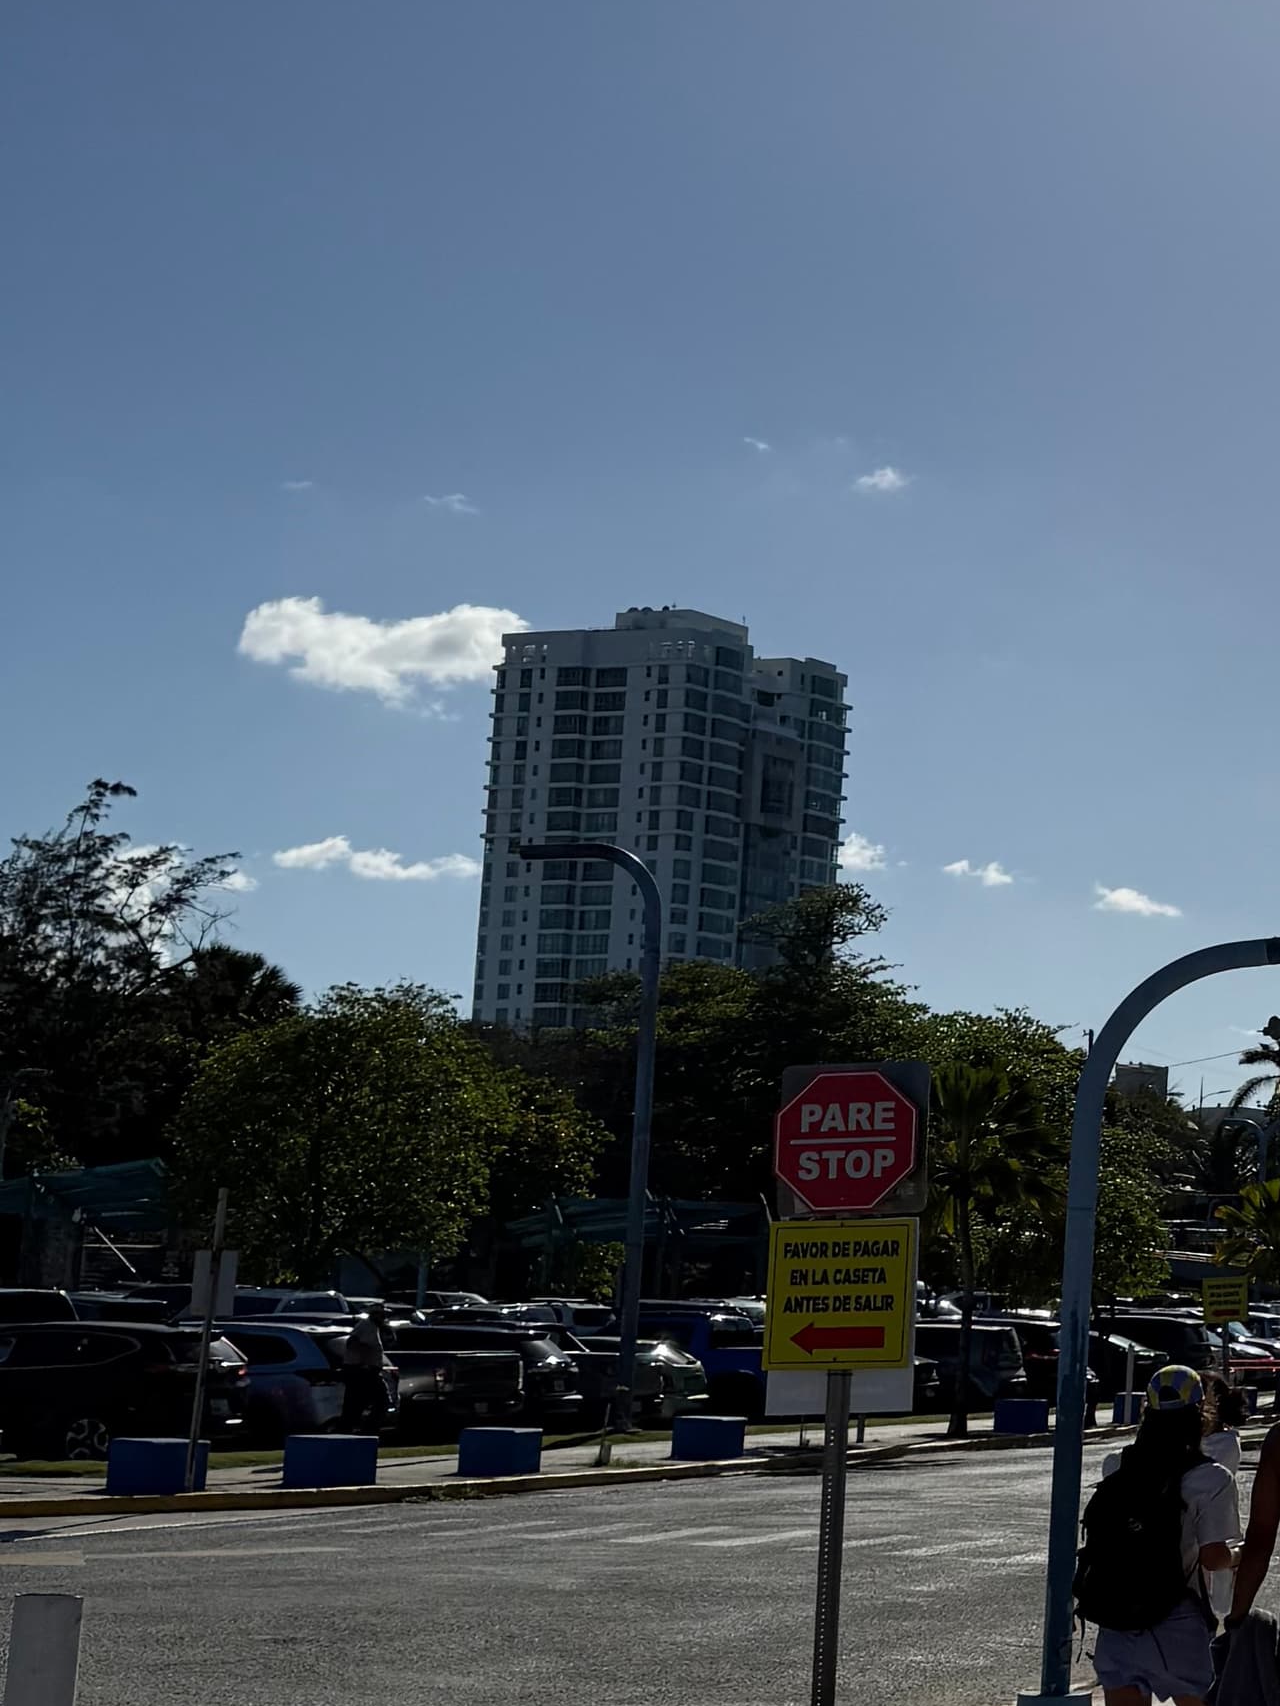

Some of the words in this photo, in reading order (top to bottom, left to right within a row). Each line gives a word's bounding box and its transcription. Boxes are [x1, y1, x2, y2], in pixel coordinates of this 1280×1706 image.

[800, 1101, 896, 1133] PARE
[798, 1148, 896, 1181] STOP
[784, 1242, 828, 1259] FAVOR
[832, 1241, 850, 1258] DE
[853, 1240, 900, 1257] PAGAR
[790, 1269, 808, 1286] EN
[812, 1268, 829, 1286] LA
[833, 1267, 887, 1285] CASETA
[783, 1296, 829, 1313] ANTES
[832, 1295, 851, 1312] DE
[853, 1295, 894, 1312] SALIR
